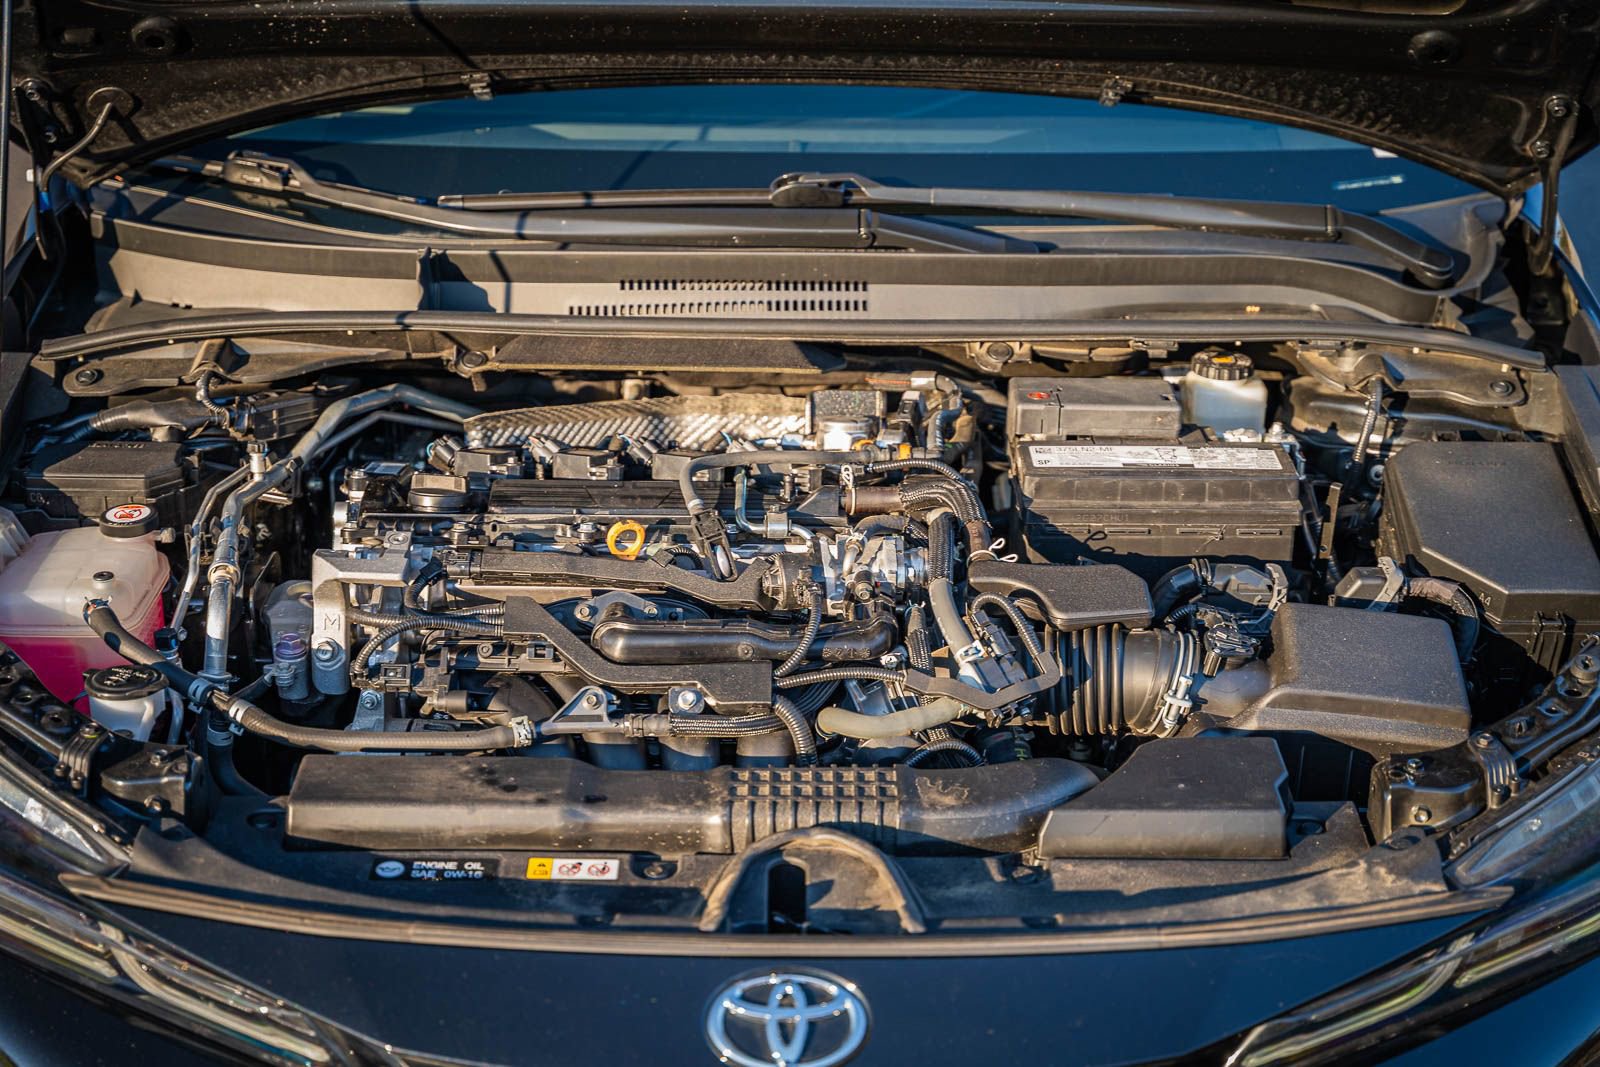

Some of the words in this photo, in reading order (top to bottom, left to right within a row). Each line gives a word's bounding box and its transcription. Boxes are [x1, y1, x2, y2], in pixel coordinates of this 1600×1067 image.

[323, 612, 341, 631] M
[411, 861, 458, 870] ENGINE
[463, 861, 485, 870] OIL
[410, 870, 437, 878] SAE
[443, 870, 483, 879] 0W-16
